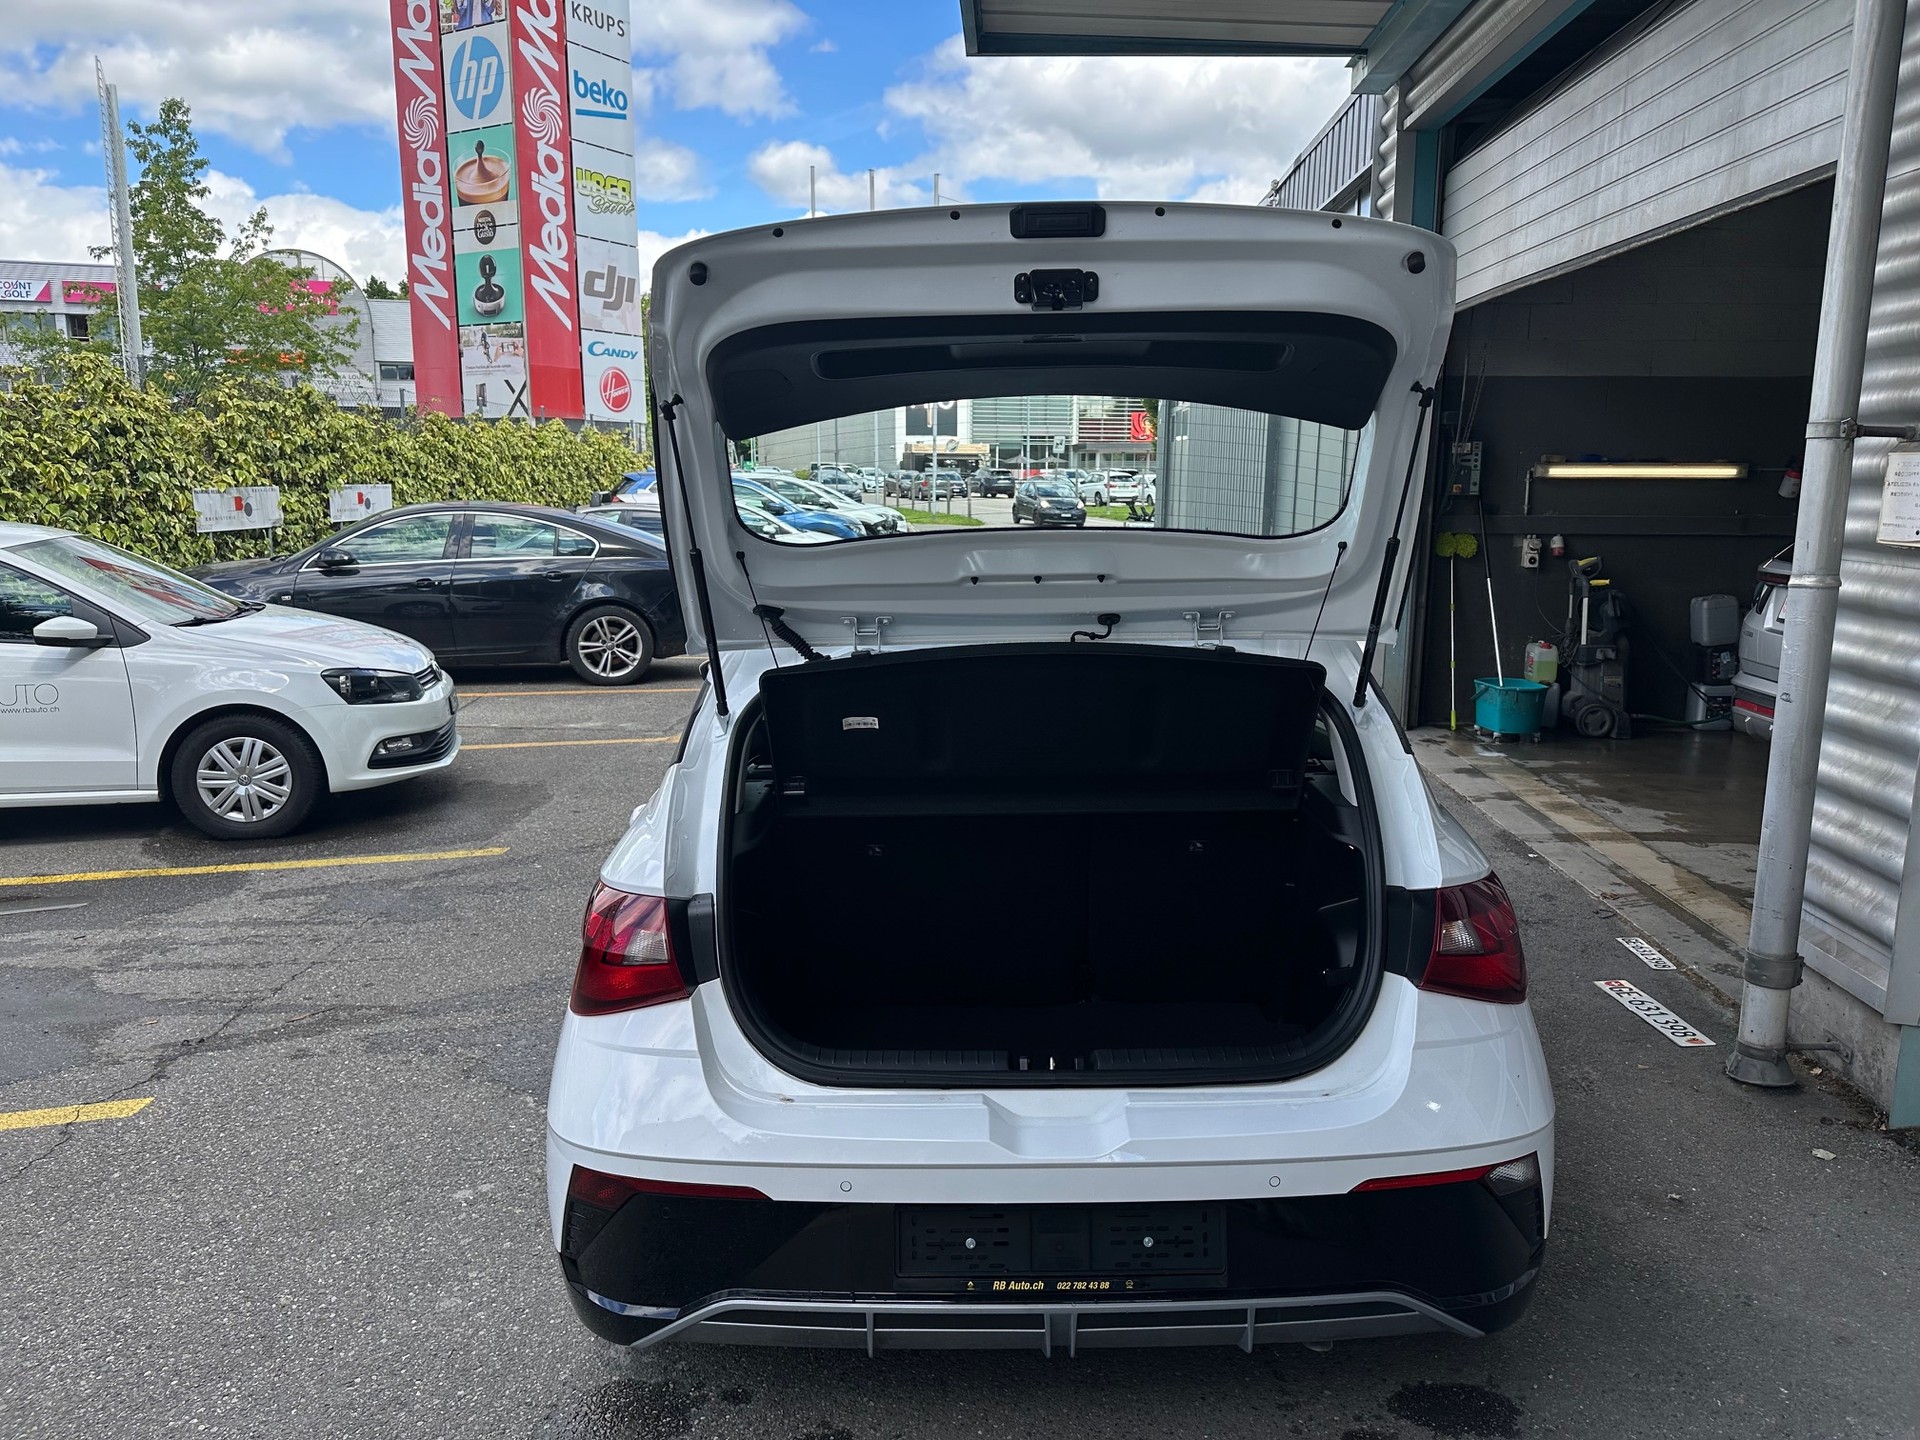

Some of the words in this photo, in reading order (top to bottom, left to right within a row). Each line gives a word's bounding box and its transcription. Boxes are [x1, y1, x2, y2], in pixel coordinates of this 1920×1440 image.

[571, 1, 625, 37] KRUPS
[457, 36, 499, 120] hp
[573, 69, 628, 111] beko
[575, 166, 631, 204] UBER
[587, 195, 635, 216] Scoot
[412, 146, 451, 331] Media
[529, 141, 572, 331] Media
[0, 281, 32, 290] OUNT
[4, 289, 31, 299] GOLF
[587, 341, 639, 359] CANDY
[992, 1280, 1006, 1290] RB
[1008, 1280, 1045, 1290] Auto.ch
[1056, 1281, 1071, 1290] 022
[1073, 1281, 1087, 1290] 782
[1088, 1281, 1098, 1290] 43
[1100, 1281, 1110, 1290] 88
